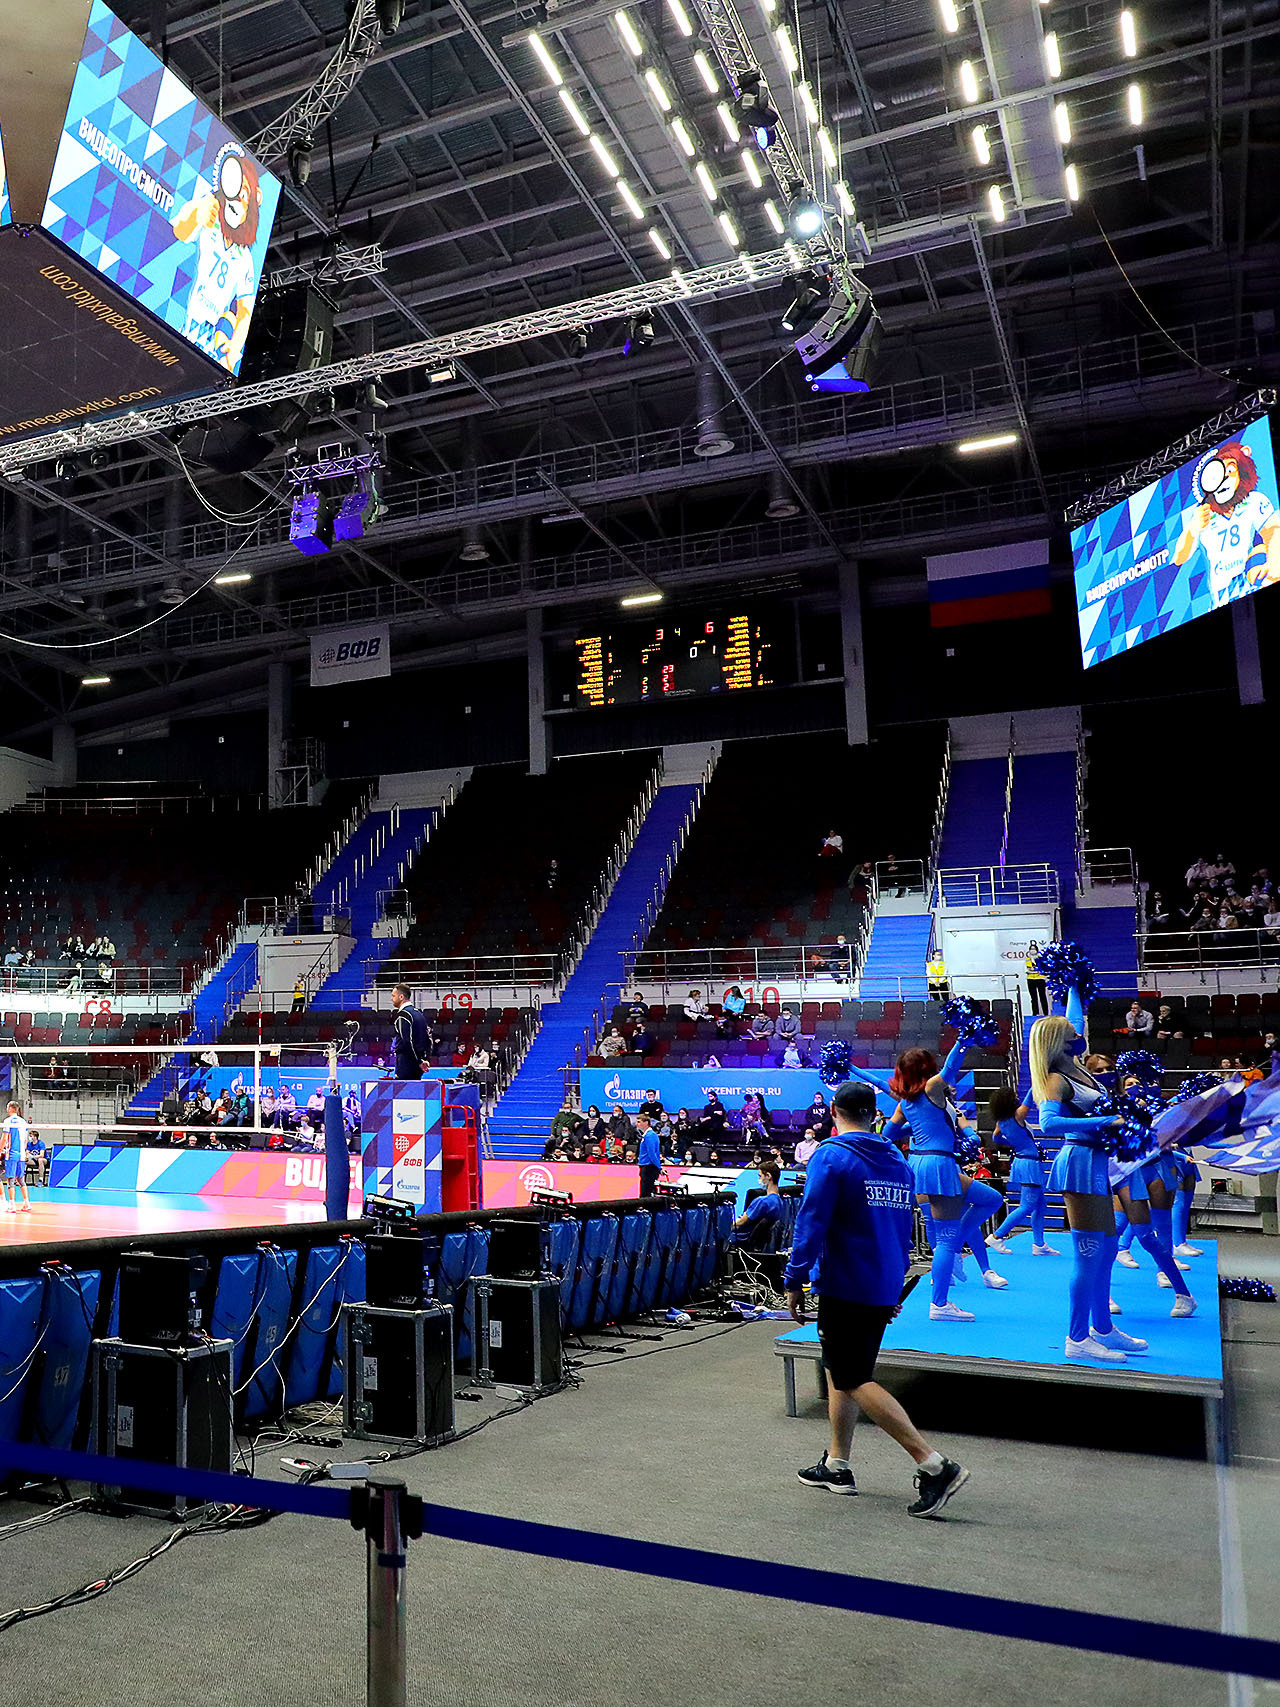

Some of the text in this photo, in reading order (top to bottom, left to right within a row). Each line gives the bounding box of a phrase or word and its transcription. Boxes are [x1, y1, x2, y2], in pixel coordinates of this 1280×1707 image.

[78, 116, 174, 213] ВИДЕОПРОСМОТР
[208, 250, 229, 289] 78
[38, 264, 180, 368] www.megaluxltd.com
[1217, 524, 1241, 553] 78
[1086, 548, 1170, 604] ВИДЕОПРОСМОТР
[656, 628, 665, 641] 3
[674, 627, 681, 637] 4
[705, 621, 715, 634] 6
[336, 636, 382, 662] ВФВ
[723, 986, 780, 1004] 10
[621, 1089, 661, 1100] ГАЗПРМ
[403, 1158, 423, 1167] ВФВ
[865, 1185, 911, 1204] ЗЕНИТ
